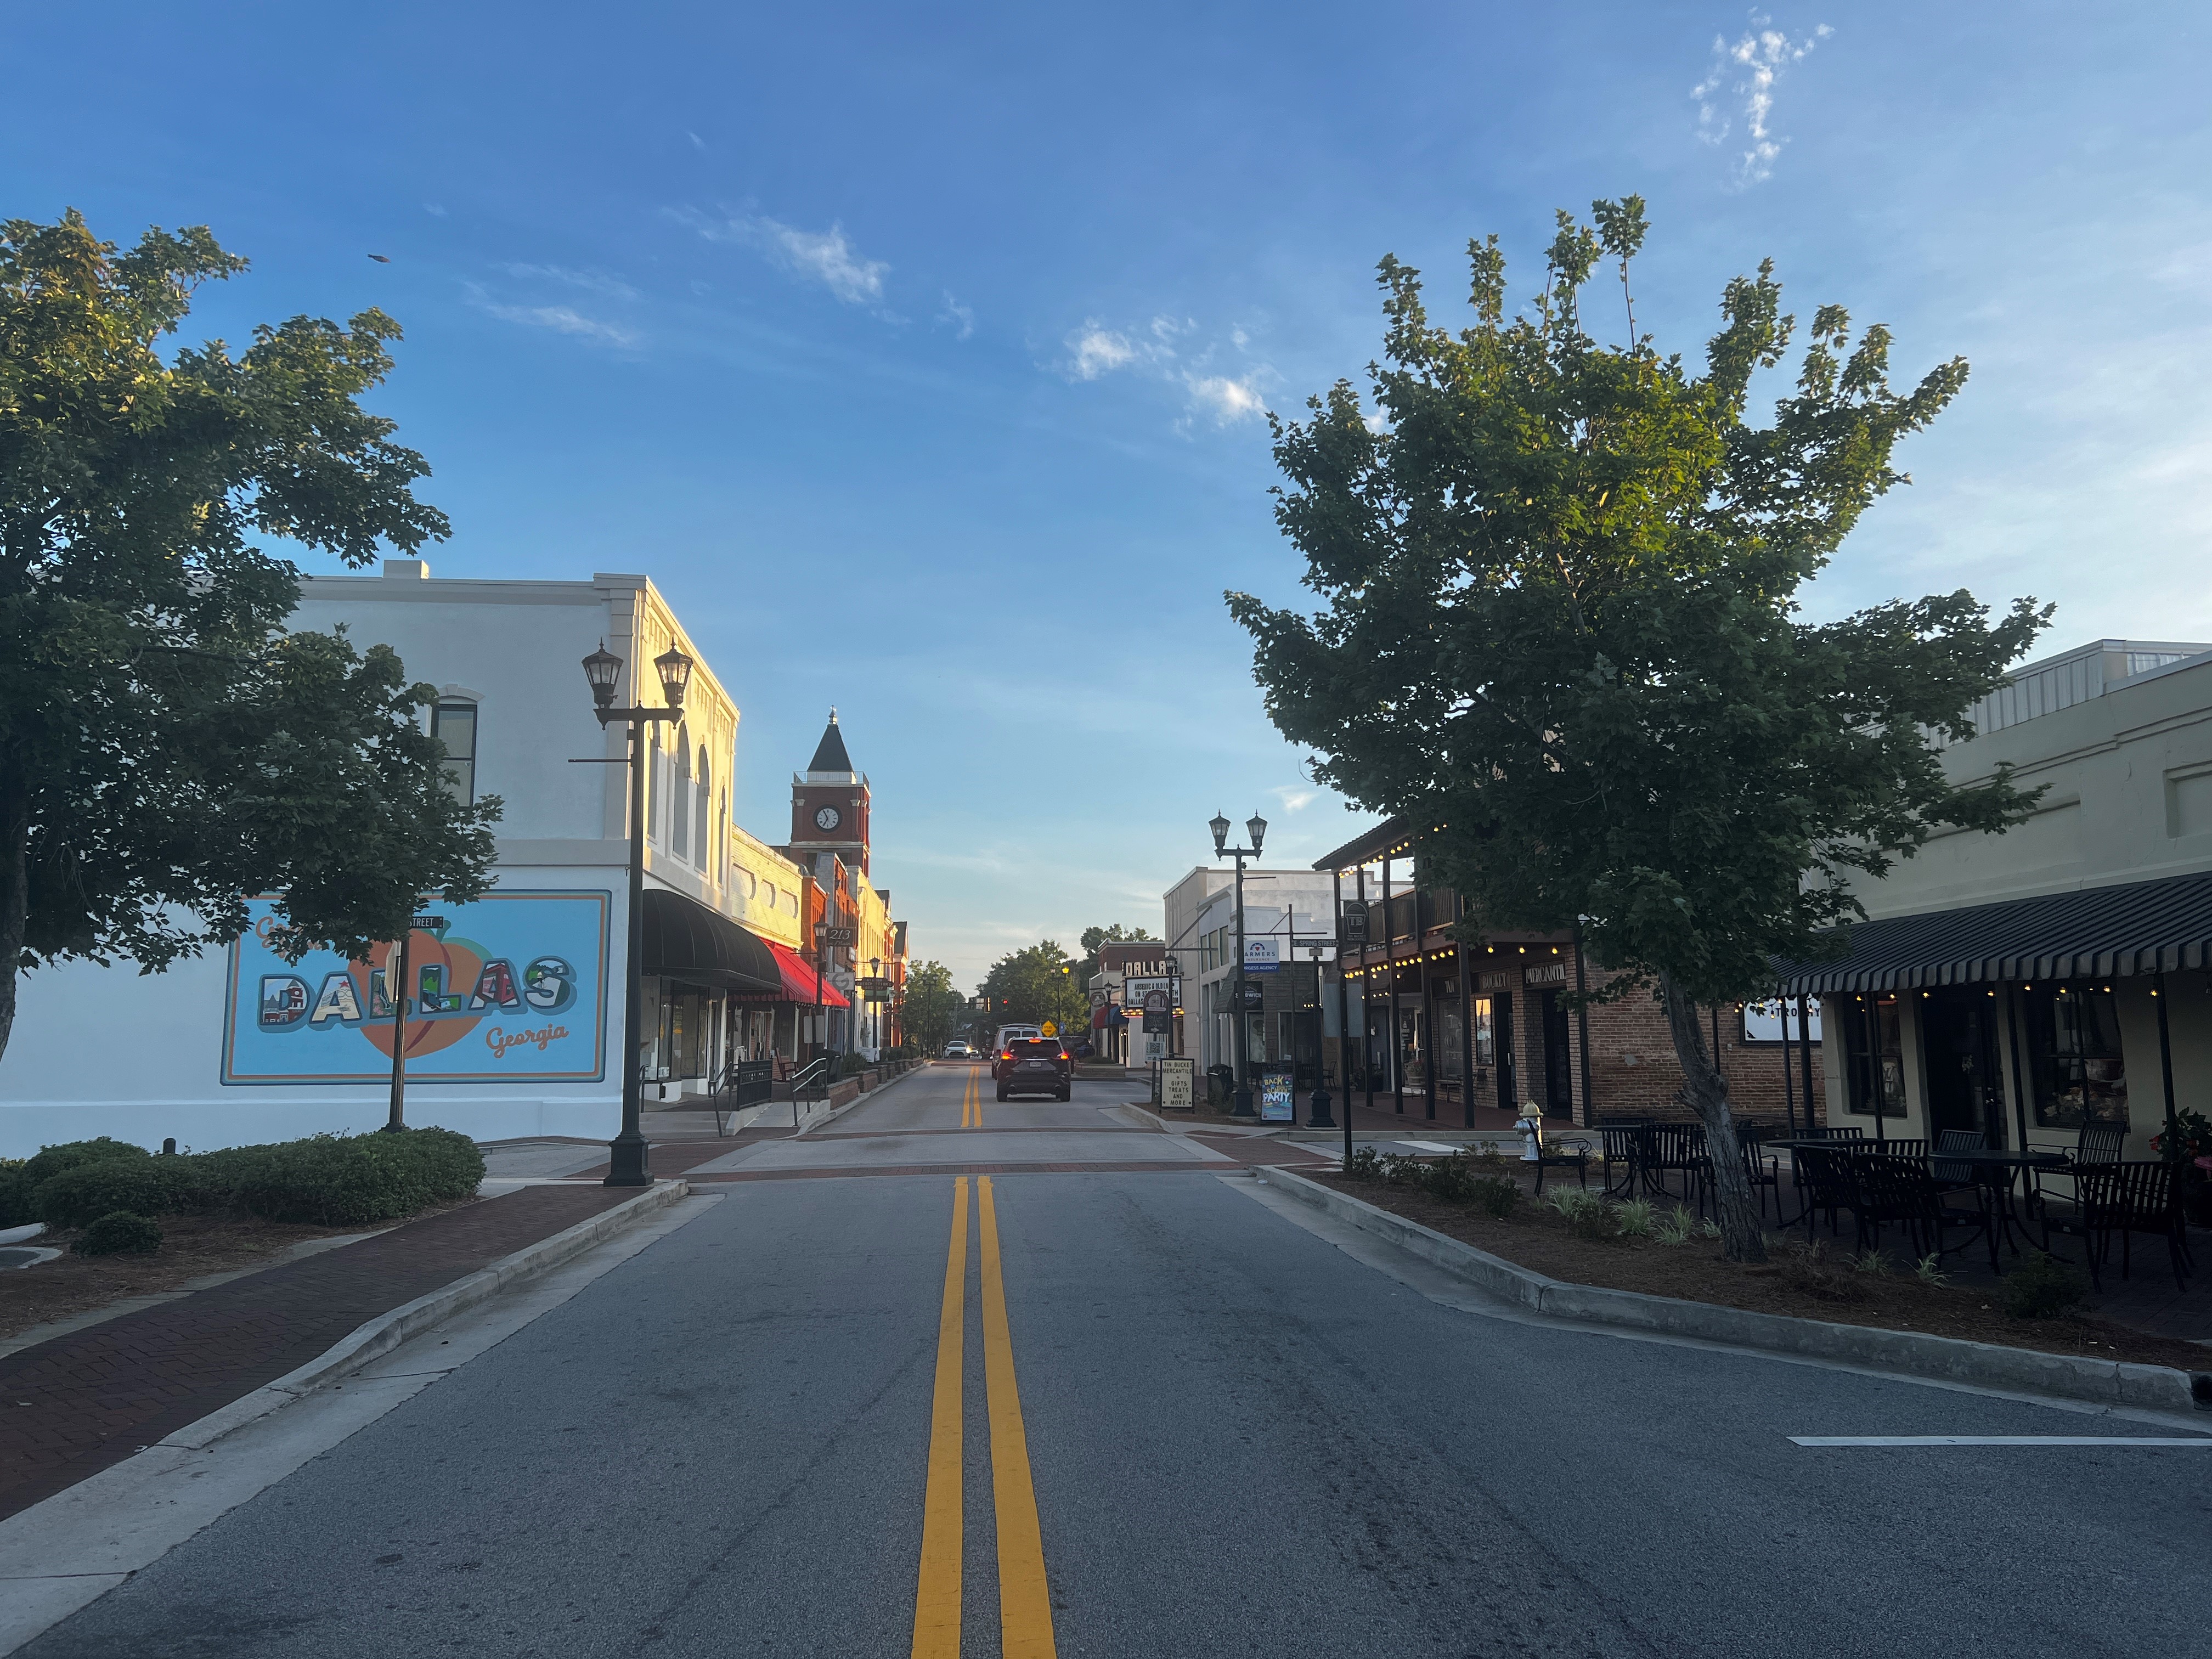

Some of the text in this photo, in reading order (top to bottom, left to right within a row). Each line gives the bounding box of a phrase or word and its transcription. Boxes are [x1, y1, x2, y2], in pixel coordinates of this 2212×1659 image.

[830, 930, 850, 940] 213
[1125, 961, 1176, 976] DALLA
[1526, 963, 1567, 984] MERCANTIL
[1444, 980, 1455, 994] TIN
[1483, 973, 1507, 988] BUCKET
[1775, 1008, 1820, 1017] TROY
[486, 1023, 571, 1058] Georgia
[1264, 1075, 1284, 1086] BACK
[1263, 1092, 1290, 1102] PARTY
